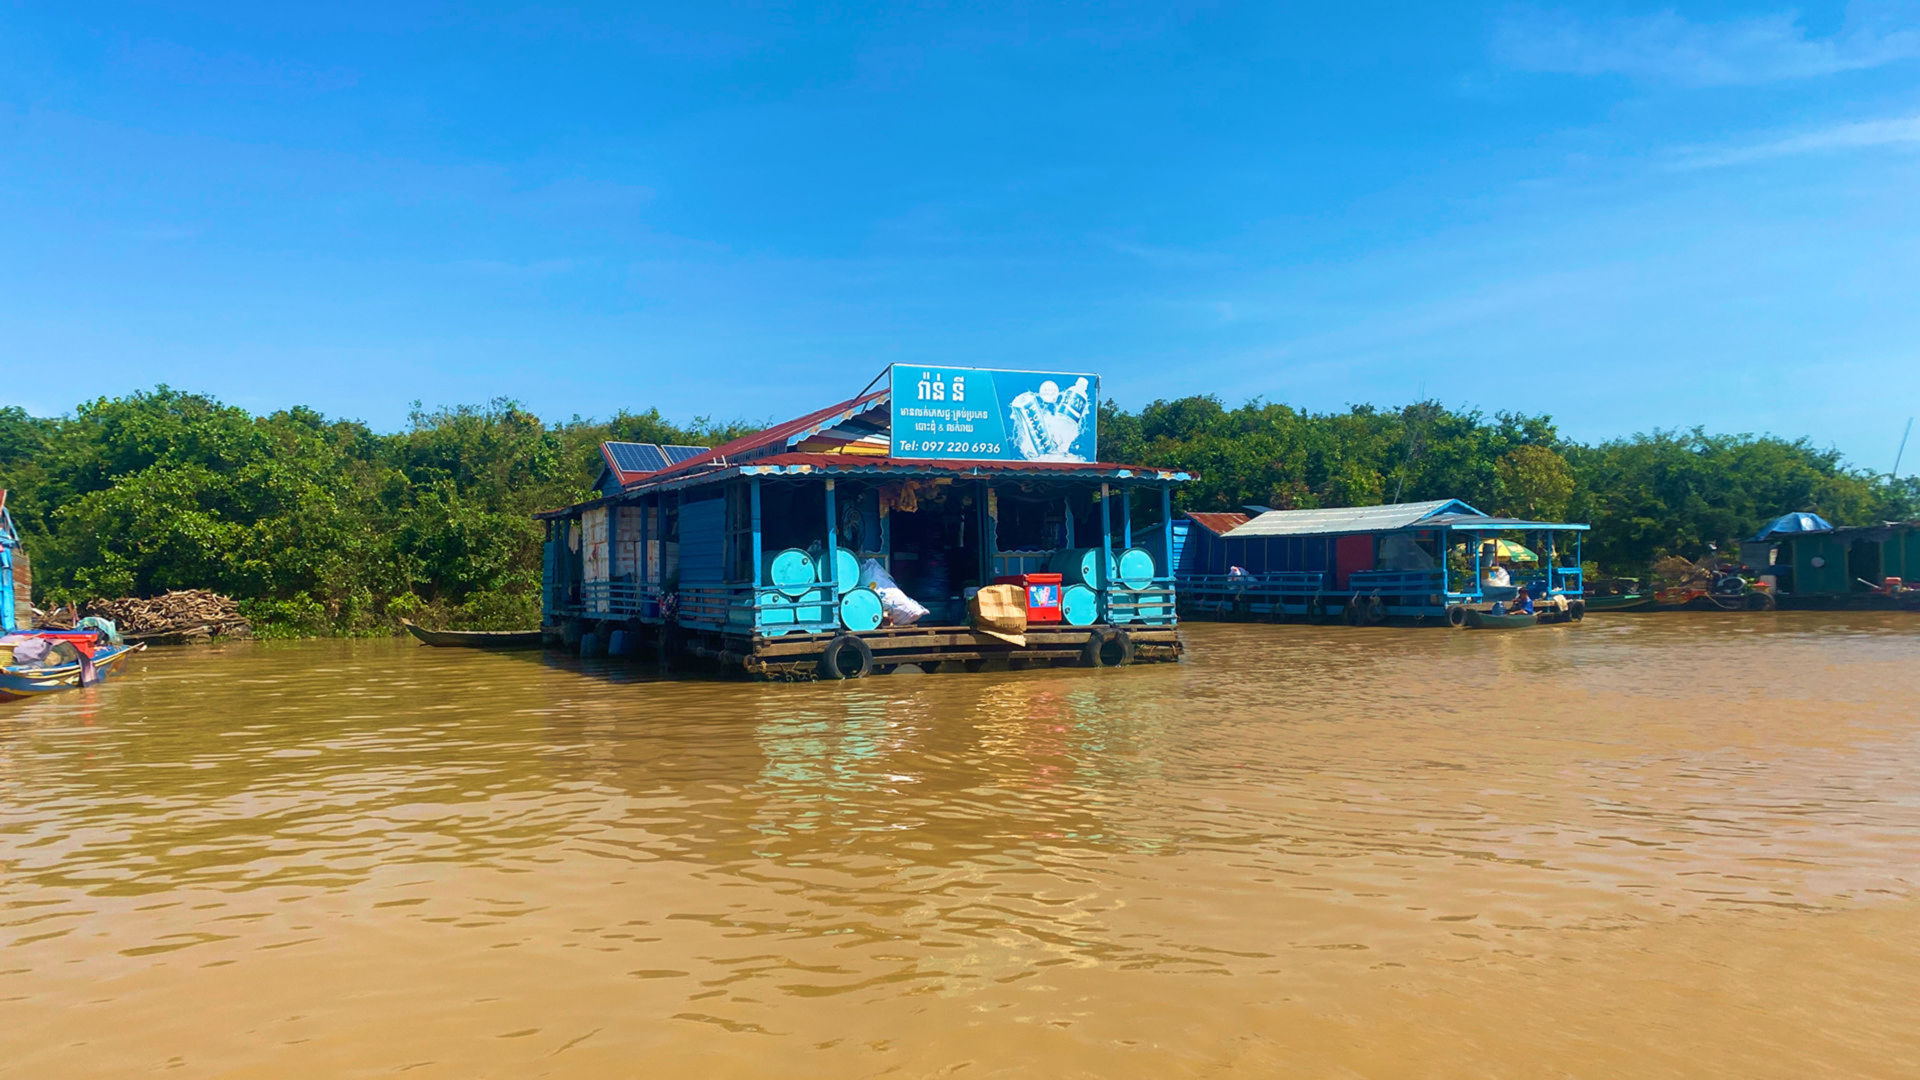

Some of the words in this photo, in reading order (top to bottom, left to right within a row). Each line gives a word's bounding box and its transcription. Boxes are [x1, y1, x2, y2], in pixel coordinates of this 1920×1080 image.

[952, 375, 964, 401] នី
[899, 440, 919, 451] Tel:
[921, 441, 945, 452] 097
[947, 442, 970, 453] 220
[971, 442, 1001, 454] 6936
